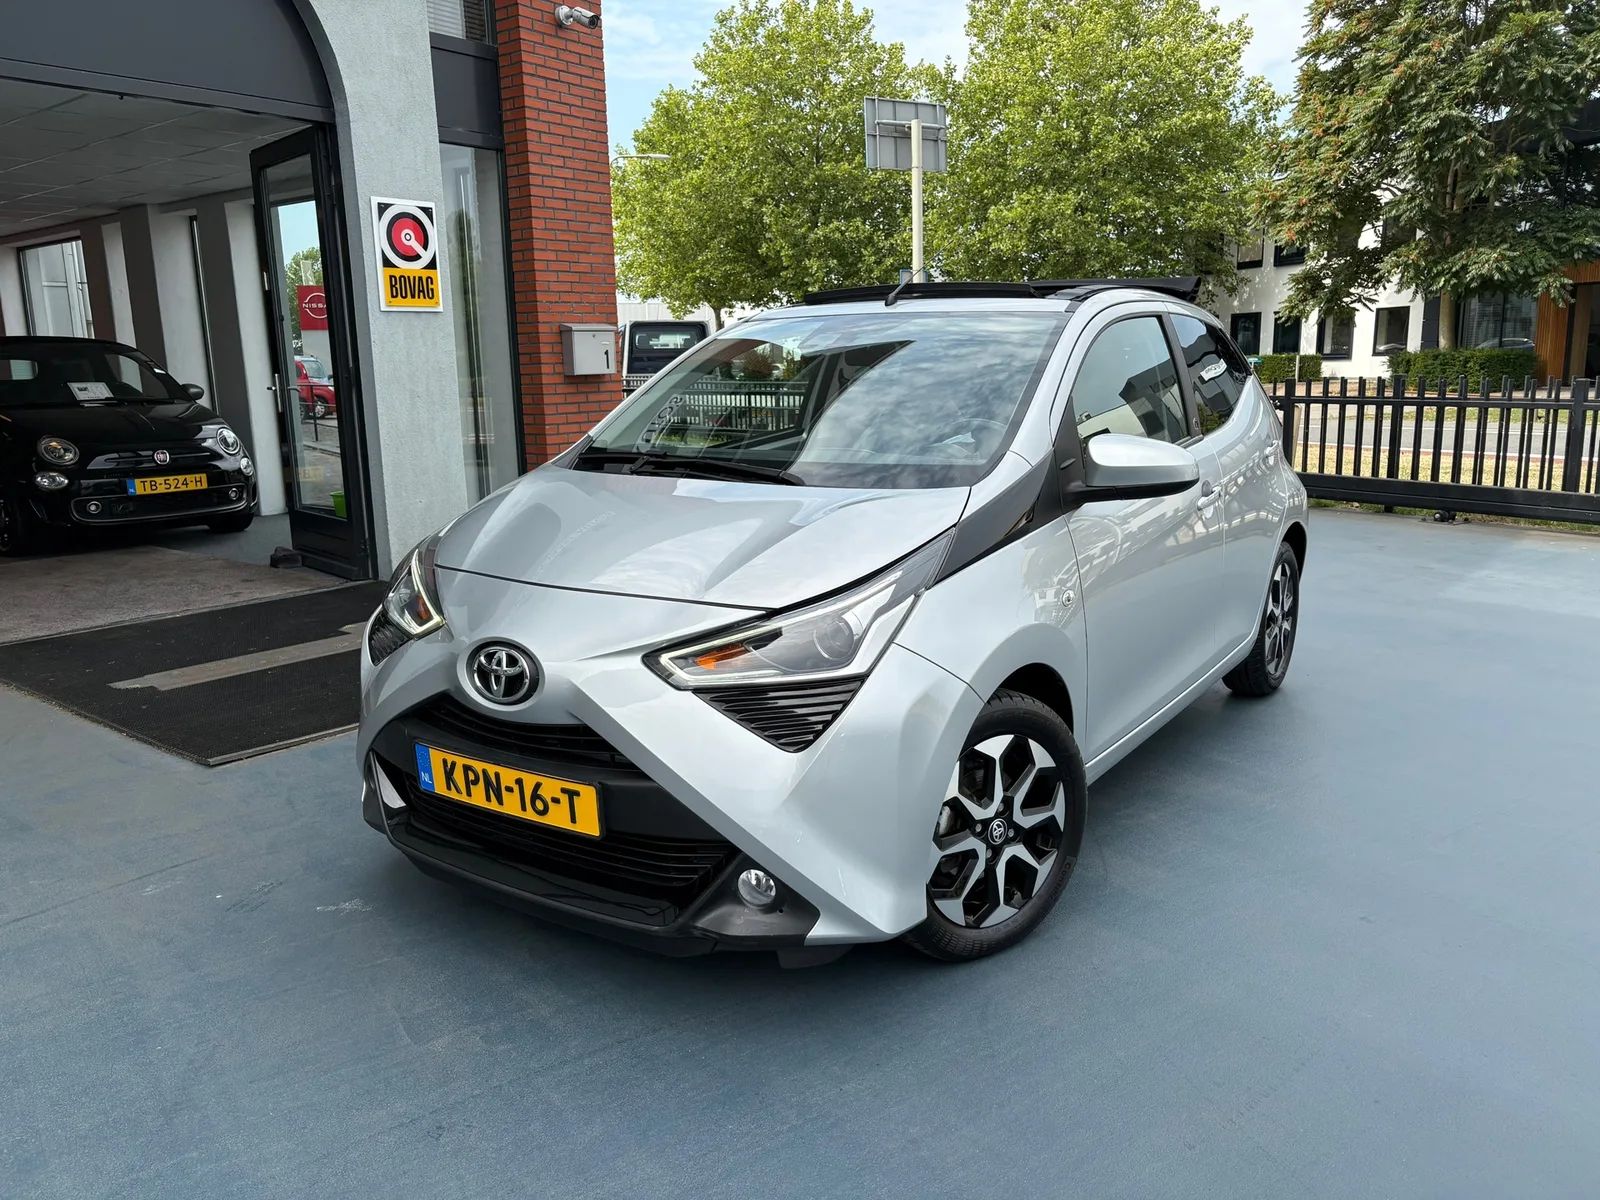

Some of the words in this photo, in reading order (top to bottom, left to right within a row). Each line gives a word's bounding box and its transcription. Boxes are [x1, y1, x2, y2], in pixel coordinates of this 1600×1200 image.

[388, 274, 435, 301] BOVAG
[604, 349, 610, 370] 1
[140, 476, 203, 492] TB-524-H
[421, 770, 433, 784] NL
[442, 757, 581, 824] KPN-16-T
